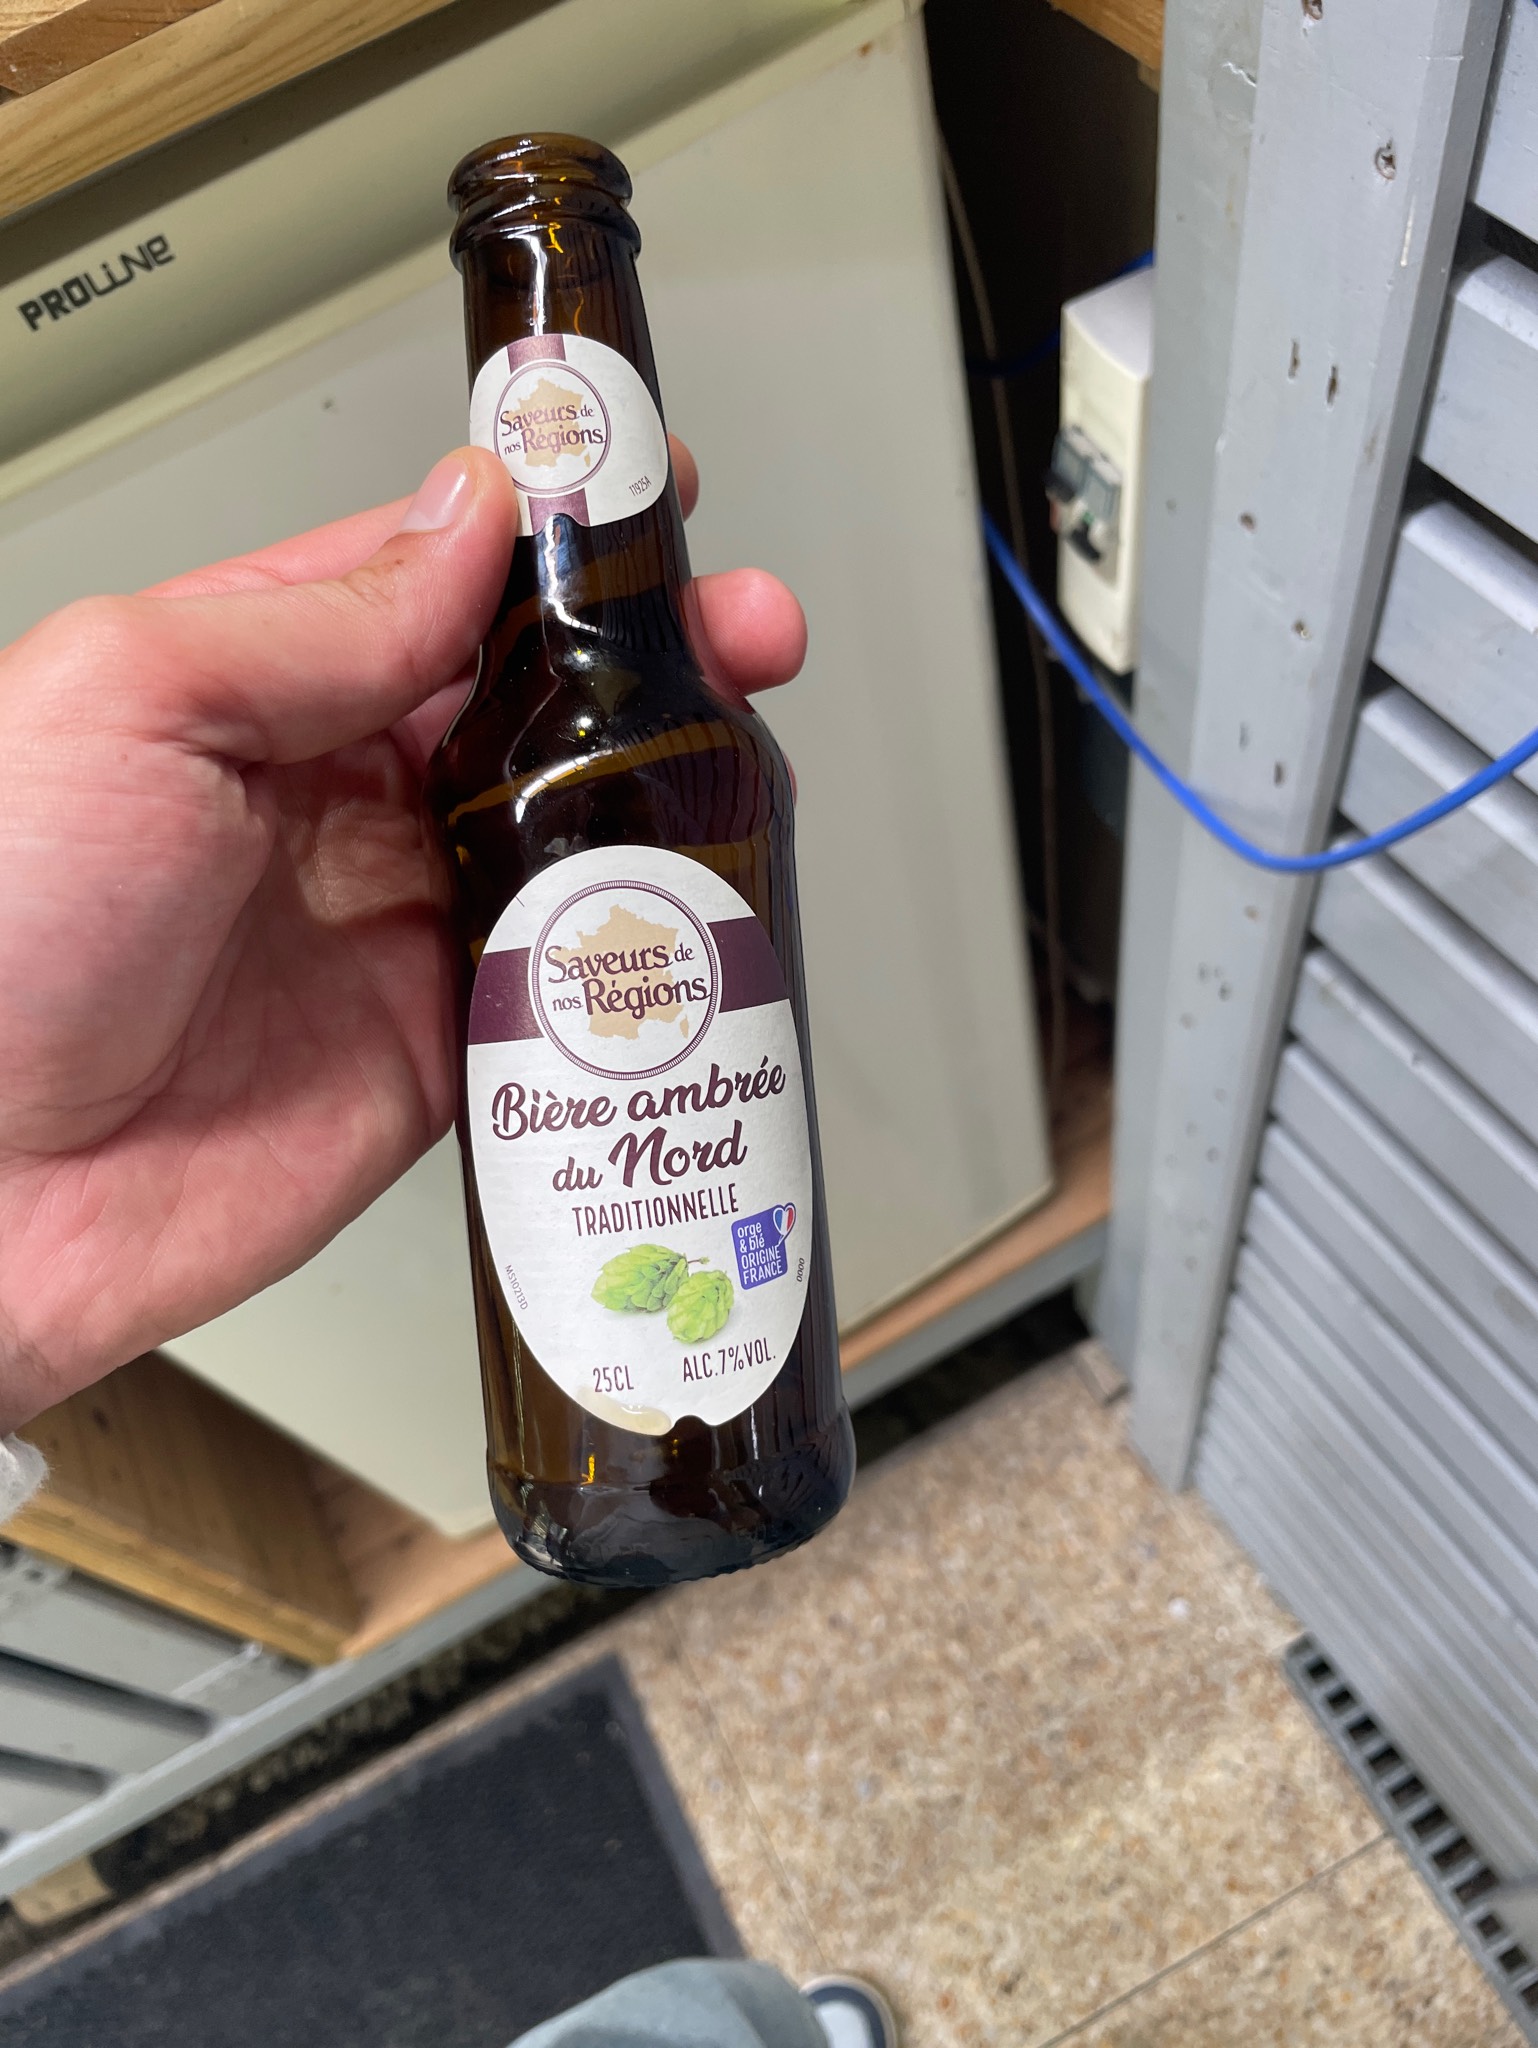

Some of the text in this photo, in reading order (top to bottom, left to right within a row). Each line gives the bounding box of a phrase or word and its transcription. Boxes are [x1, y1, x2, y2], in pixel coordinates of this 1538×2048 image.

[500, 404, 595, 437] Saveurs de
[504, 425, 606, 455] nos Régions
[629, 475, 652, 497] 11925A
[545, 942, 695, 983] Saveurs de
[552, 976, 712, 1020] nos Régions
[491, 1055, 786, 1140] Bière ambrée
[552, 1119, 748, 1192] du Nord
[572, 1183, 739, 1237] TRADITIONNELLE
[737, 1222, 762, 1238] orge
[739, 1232, 765, 1254] & blé
[741, 1244, 781, 1270] ORIGINE
[742, 1260, 783, 1285] FRANCE
[504, 1264, 529, 1311] MS10213D
[592, 1364, 635, 1393] 25CL
